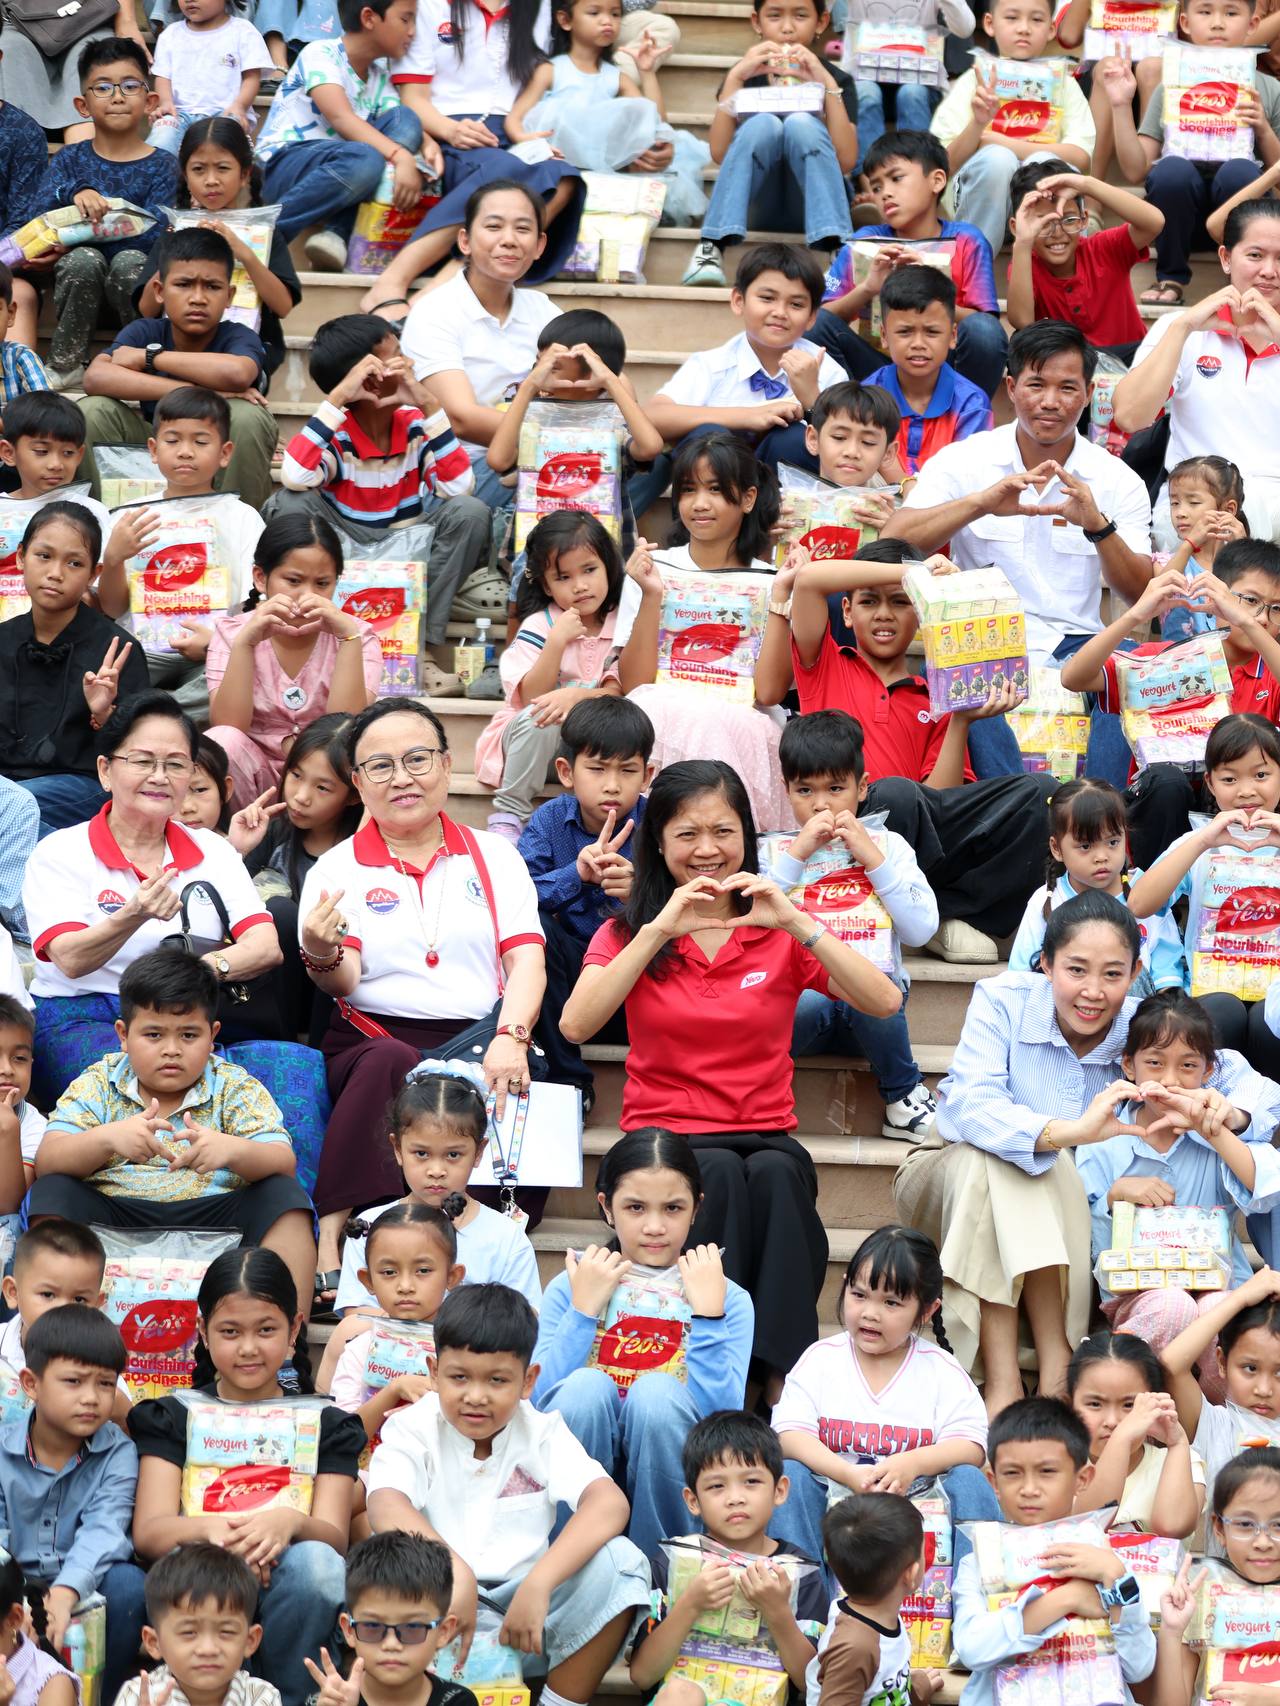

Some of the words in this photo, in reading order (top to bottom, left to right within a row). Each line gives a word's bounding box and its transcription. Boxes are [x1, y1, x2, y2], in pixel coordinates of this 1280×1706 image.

[144, 593, 211, 606] Nourishing
[671, 660, 738, 678] Nourishing
[1139, 682, 1178, 698] Yeogurt
[1232, 896, 1280, 926] Yeo's
[826, 917, 876, 930] urishing
[134, 1312, 186, 1338] Yeo's
[613, 1327, 669, 1358] Yeo's
[127, 1357, 196, 1373] ourishing
[203, 1437, 248, 1452] Yeogurt
[818, 1417, 934, 1456] SUPERSTAR
[901, 1611, 934, 1622] ness
[1224, 1621, 1271, 1634] Yeogurt
